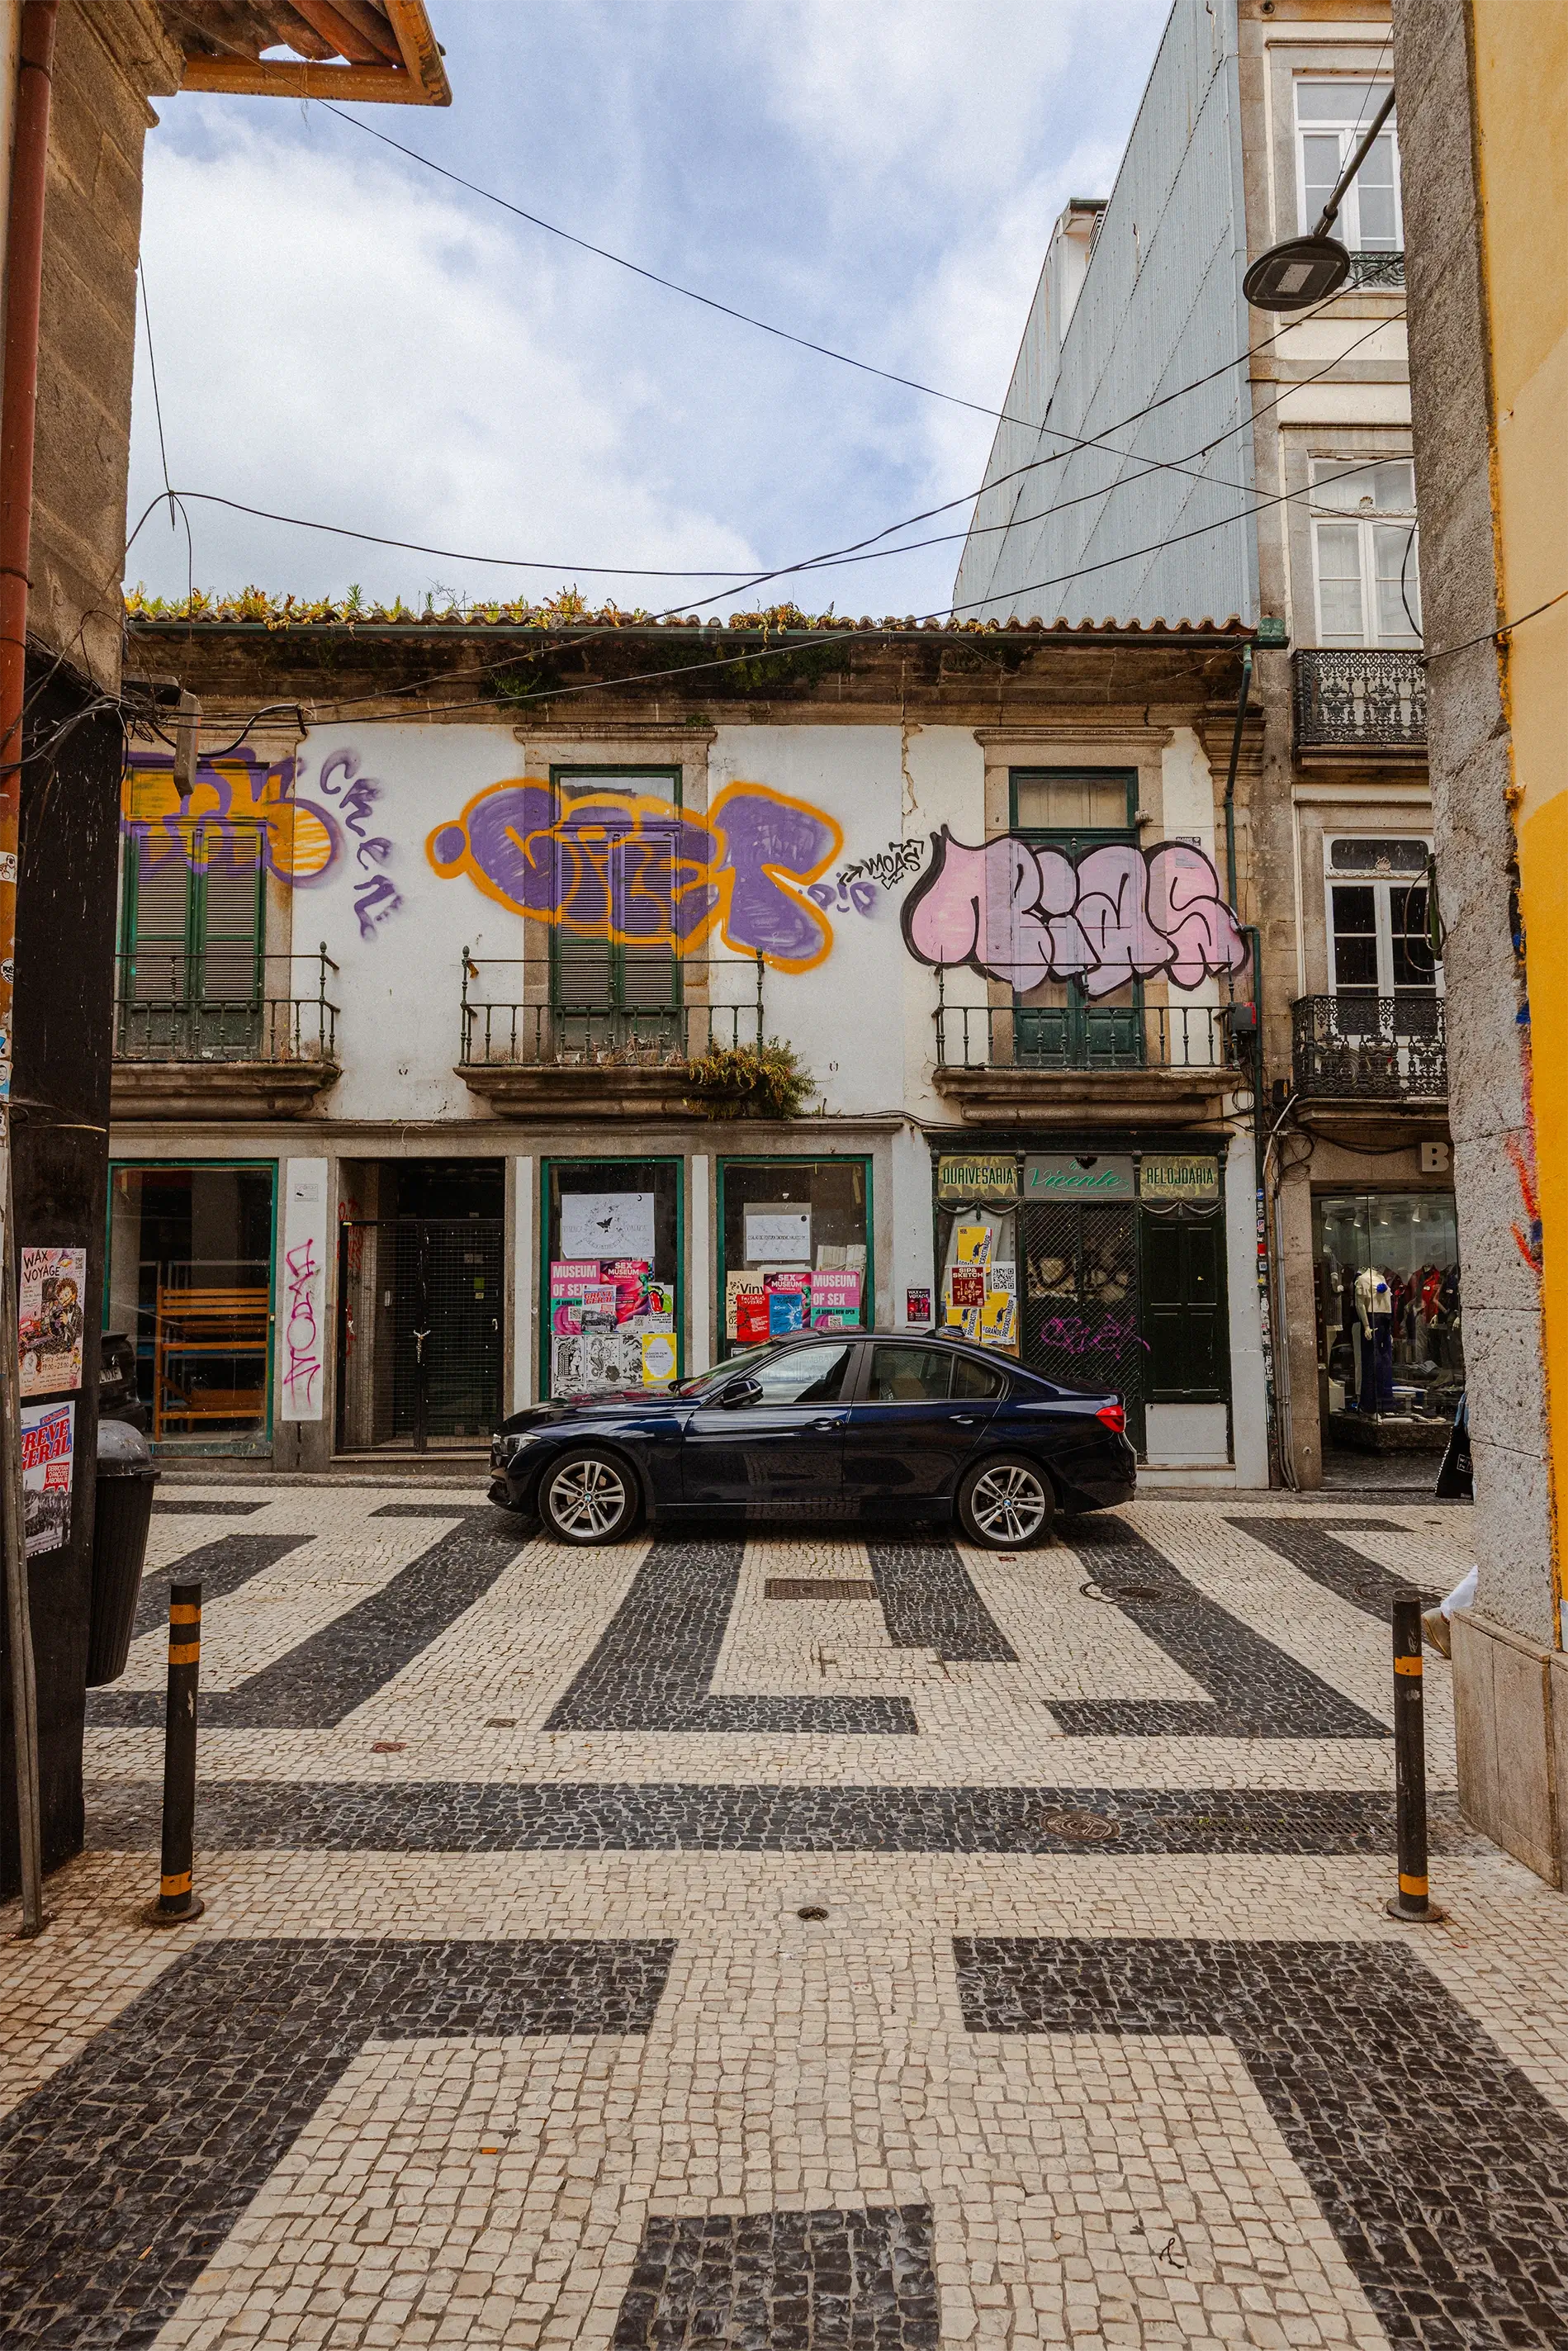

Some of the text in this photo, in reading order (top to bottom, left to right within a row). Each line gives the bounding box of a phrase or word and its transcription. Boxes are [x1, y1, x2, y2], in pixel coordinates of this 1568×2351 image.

[1421, 1142, 1449, 1172] B
[943, 1167, 1013, 1184] OURIVESARIA
[1028, 1168, 1130, 1193] Vicente
[1147, 1168, 1214, 1184] RELOJOARIA
[23, 1249, 49, 1270] WAX
[23, 1265, 61, 1283] VOYAGE
[552, 1264, 597, 1278] MUSEUM
[812, 1274, 856, 1287] MUSEUM
[552, 1283, 565, 1296] OF
[584, 1291, 613, 1300] GREVE
[812, 1292, 846, 1306] OF SEX
[985, 1326, 1002, 1337] GRANDE
[21, 1417, 70, 1453] REVE
